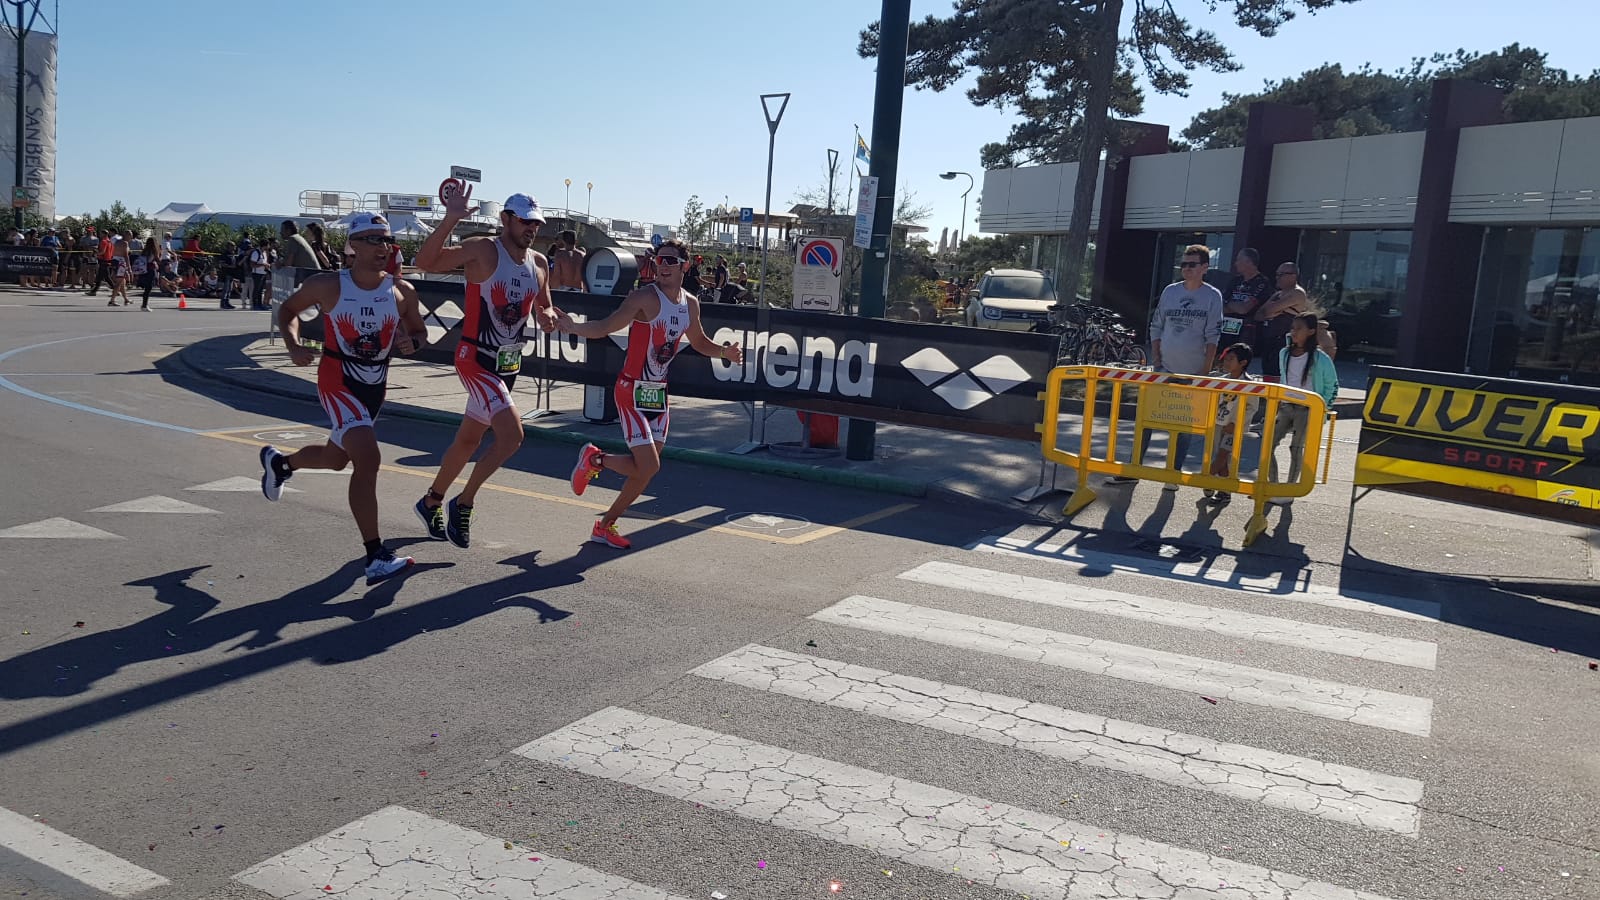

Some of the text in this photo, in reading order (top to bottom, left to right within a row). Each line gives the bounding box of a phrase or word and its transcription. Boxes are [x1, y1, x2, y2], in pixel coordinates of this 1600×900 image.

[511, 277, 521, 288] ITA
[360, 306, 375, 317] ITA
[670, 315, 679, 326] ITA
[710, 326, 878, 398] arena
[640, 389, 659, 402] 550
[1368, 381, 1600, 453] LIVER
[1443, 447, 1548, 475] SPORT
